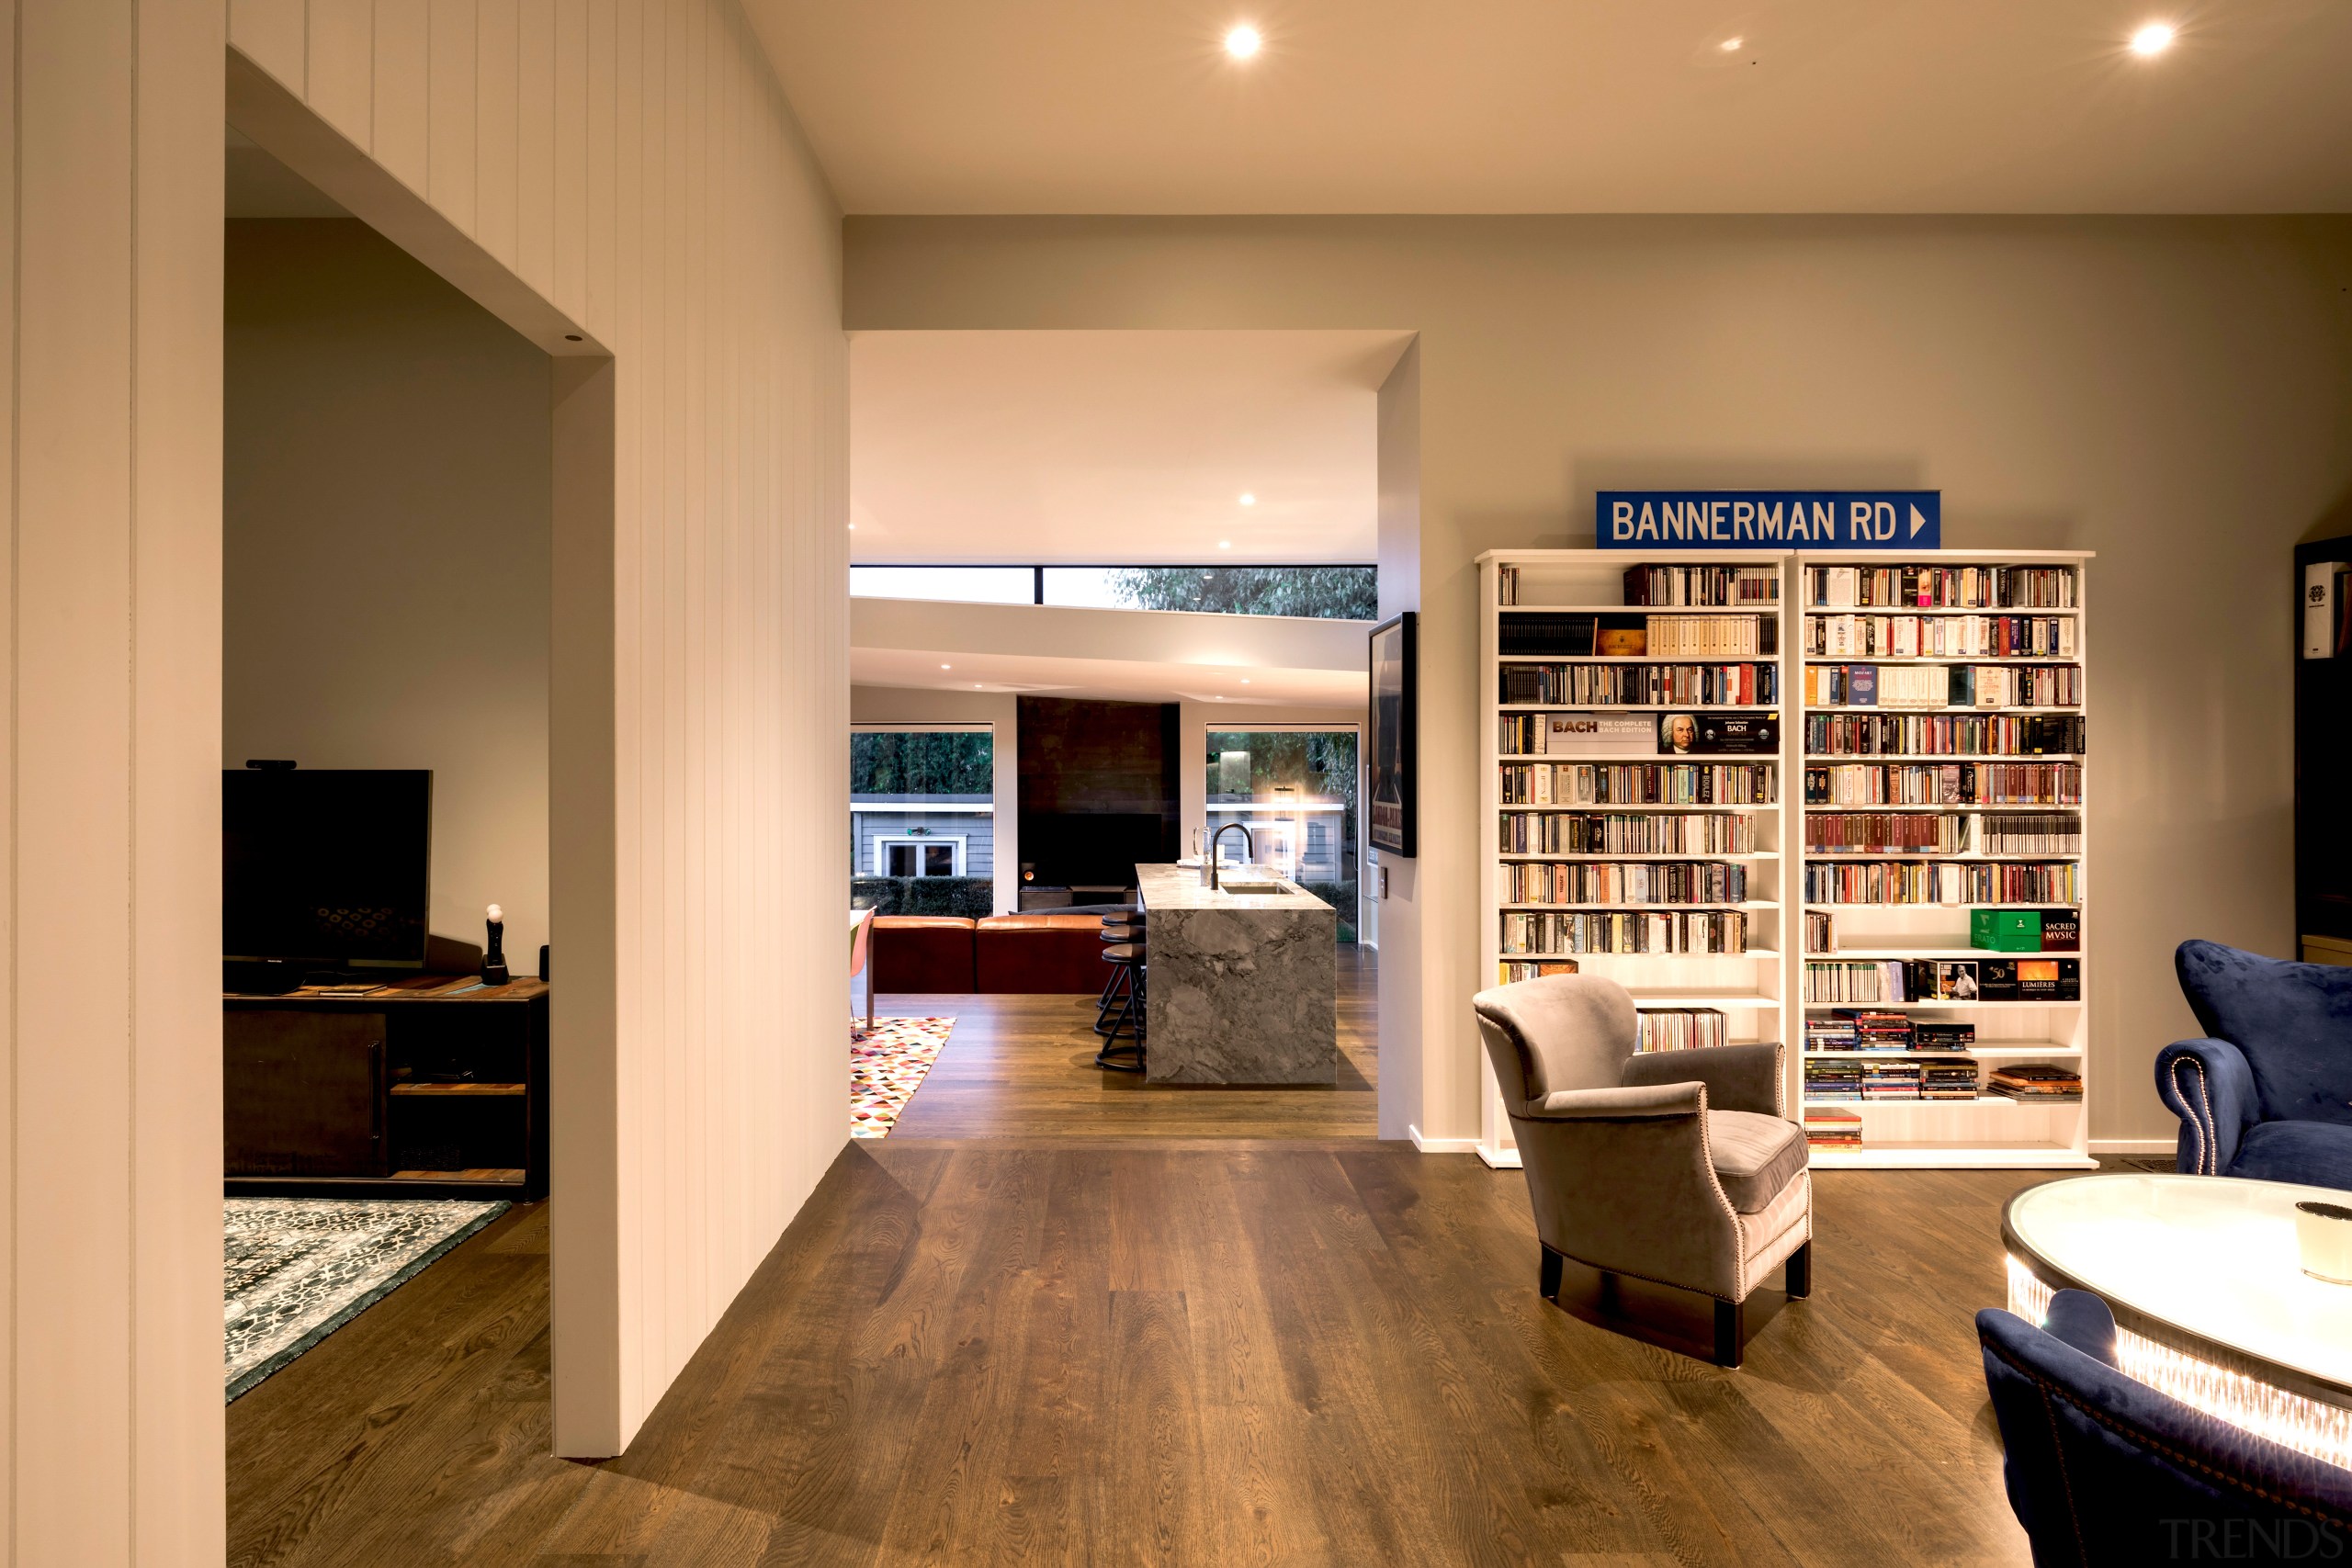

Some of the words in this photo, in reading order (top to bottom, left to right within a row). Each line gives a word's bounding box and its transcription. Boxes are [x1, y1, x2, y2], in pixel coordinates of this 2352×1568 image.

[1612, 501, 1835, 541] BANNERMAN
[1850, 502, 1896, 541] RD
[1553, 721, 1598, 733] BACH
[1974, 934, 1996, 944] ERATO
